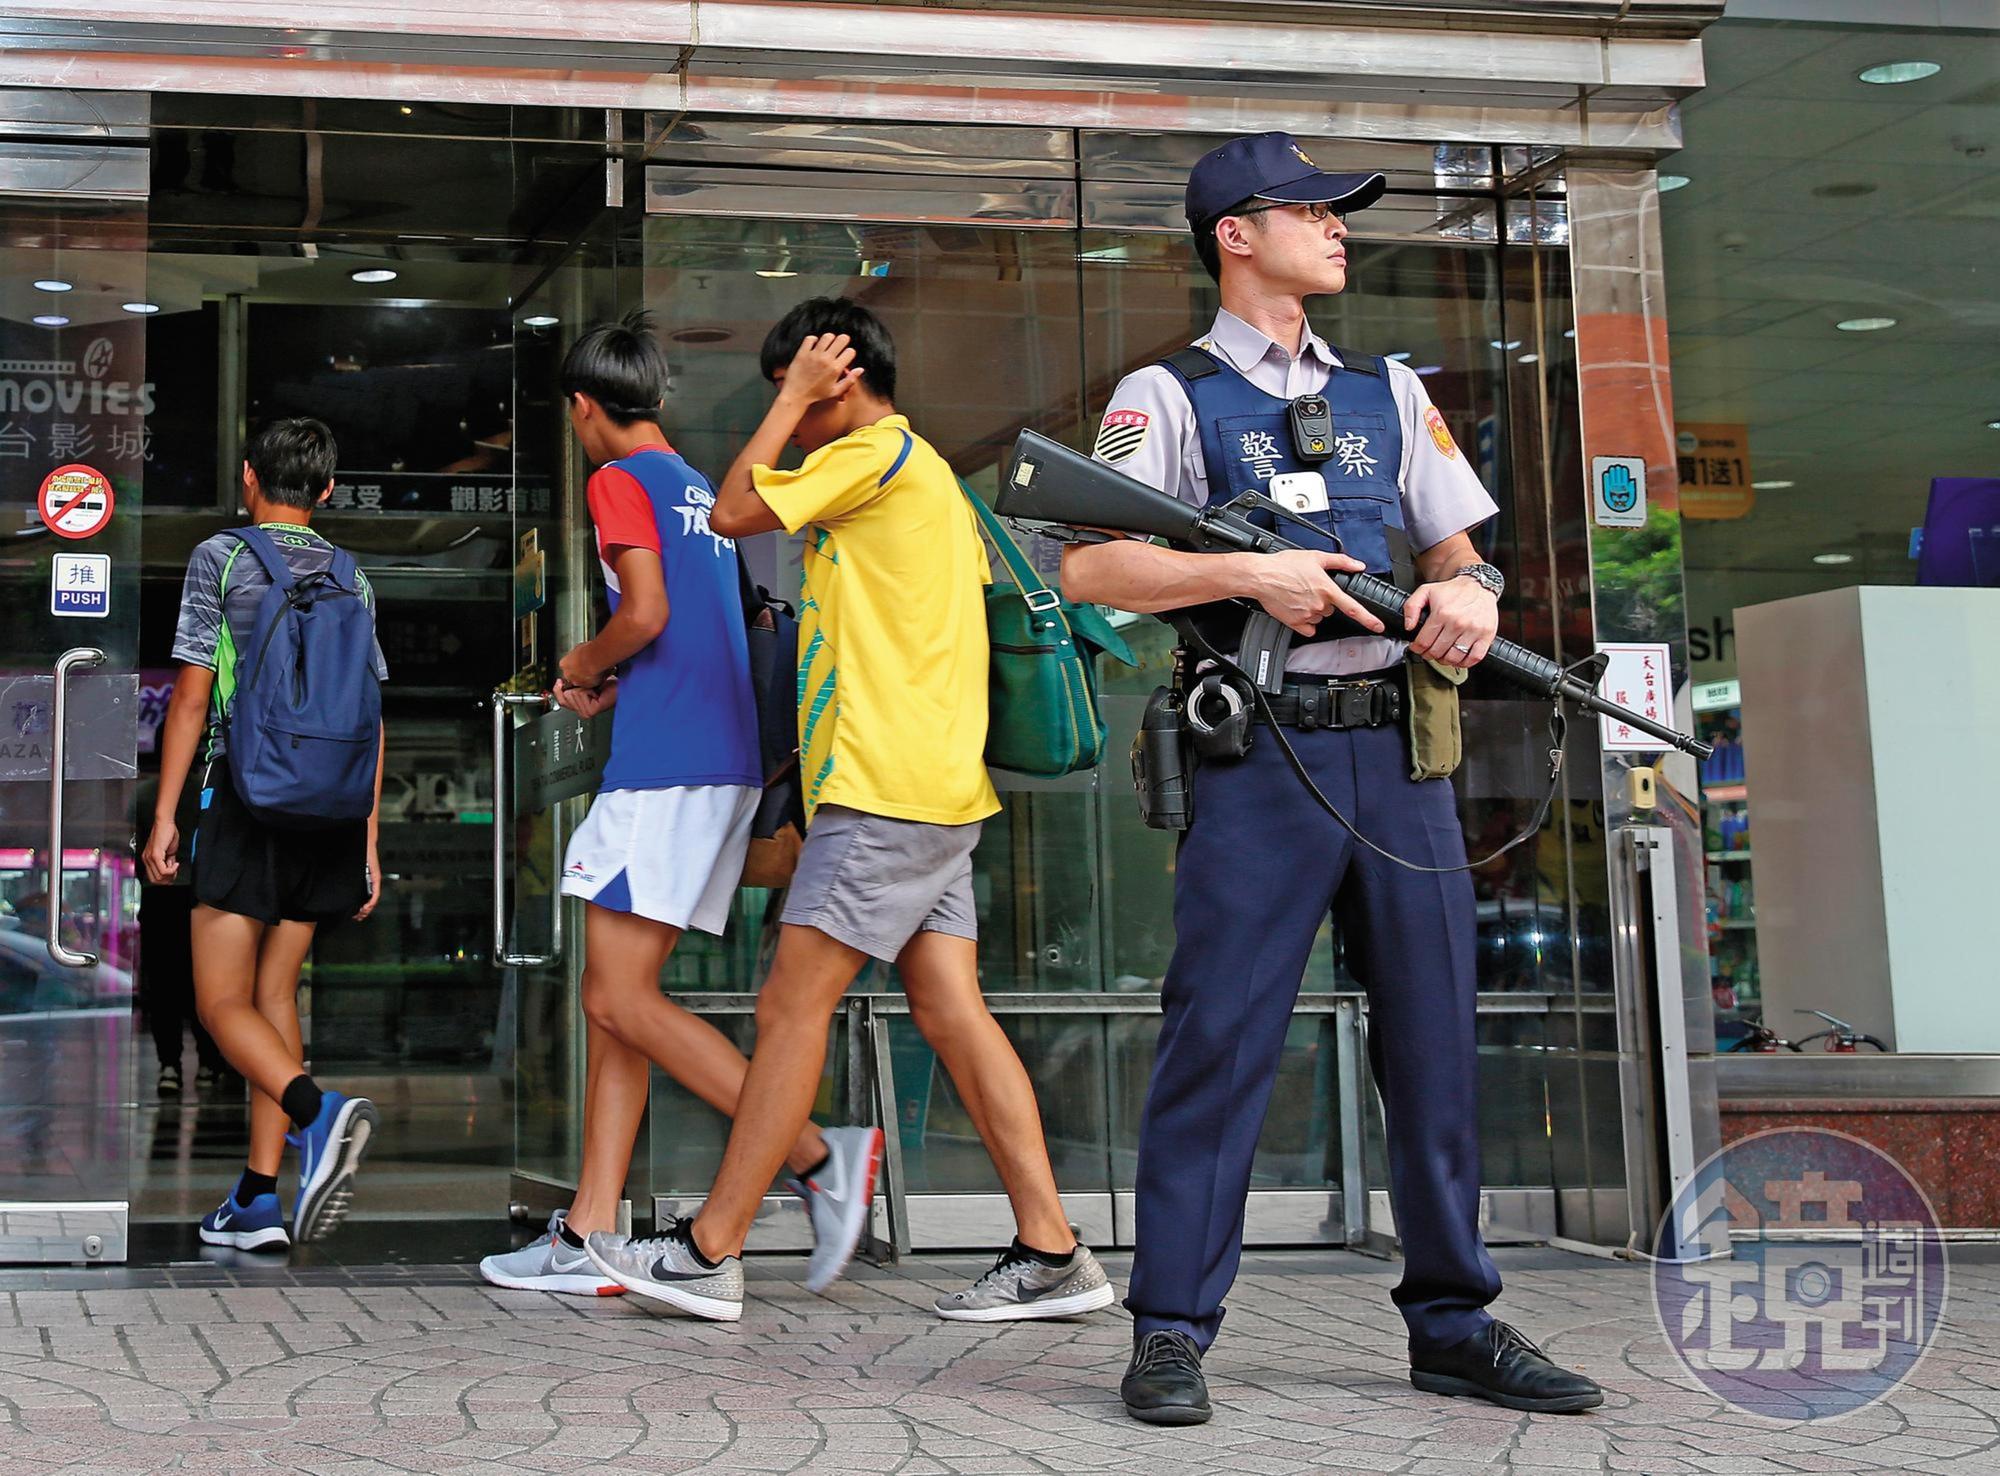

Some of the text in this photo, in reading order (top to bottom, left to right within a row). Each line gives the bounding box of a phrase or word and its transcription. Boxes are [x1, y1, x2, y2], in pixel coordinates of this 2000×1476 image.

[0, 421, 154, 461] 台影城
[317, 485, 382, 509] 享受
[68, 563, 96, 585] 推
[61, 592, 101, 605] PUSH
[1643, 655, 1658, 720] 天台廣場
[1616, 690, 1631, 739] 服鈴
